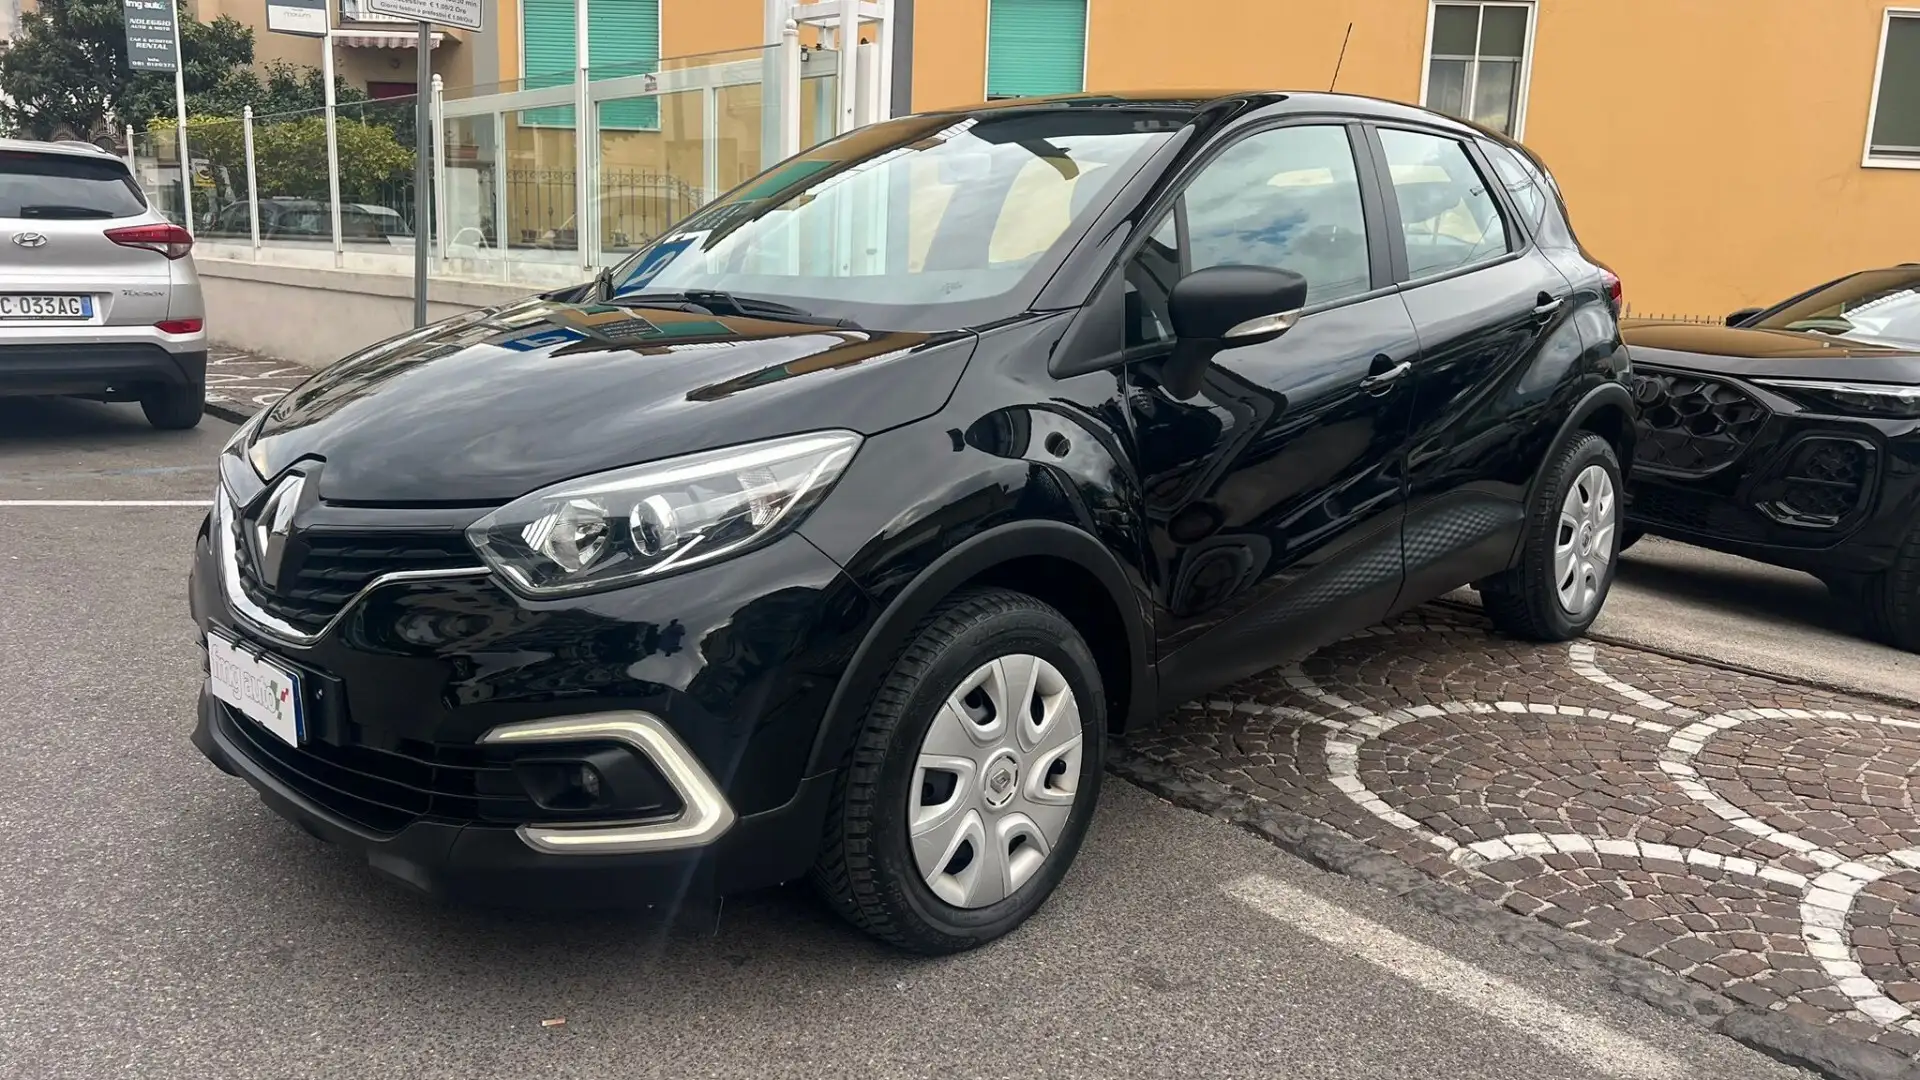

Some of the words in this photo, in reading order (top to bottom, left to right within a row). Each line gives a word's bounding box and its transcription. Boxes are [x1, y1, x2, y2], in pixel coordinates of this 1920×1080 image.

[380, 1, 398, 10] Giorni
[455, 6, 467, 14] Ore
[129, 18, 172, 27] NOLEGGIO
[135, 42, 169, 50] RENTAL
